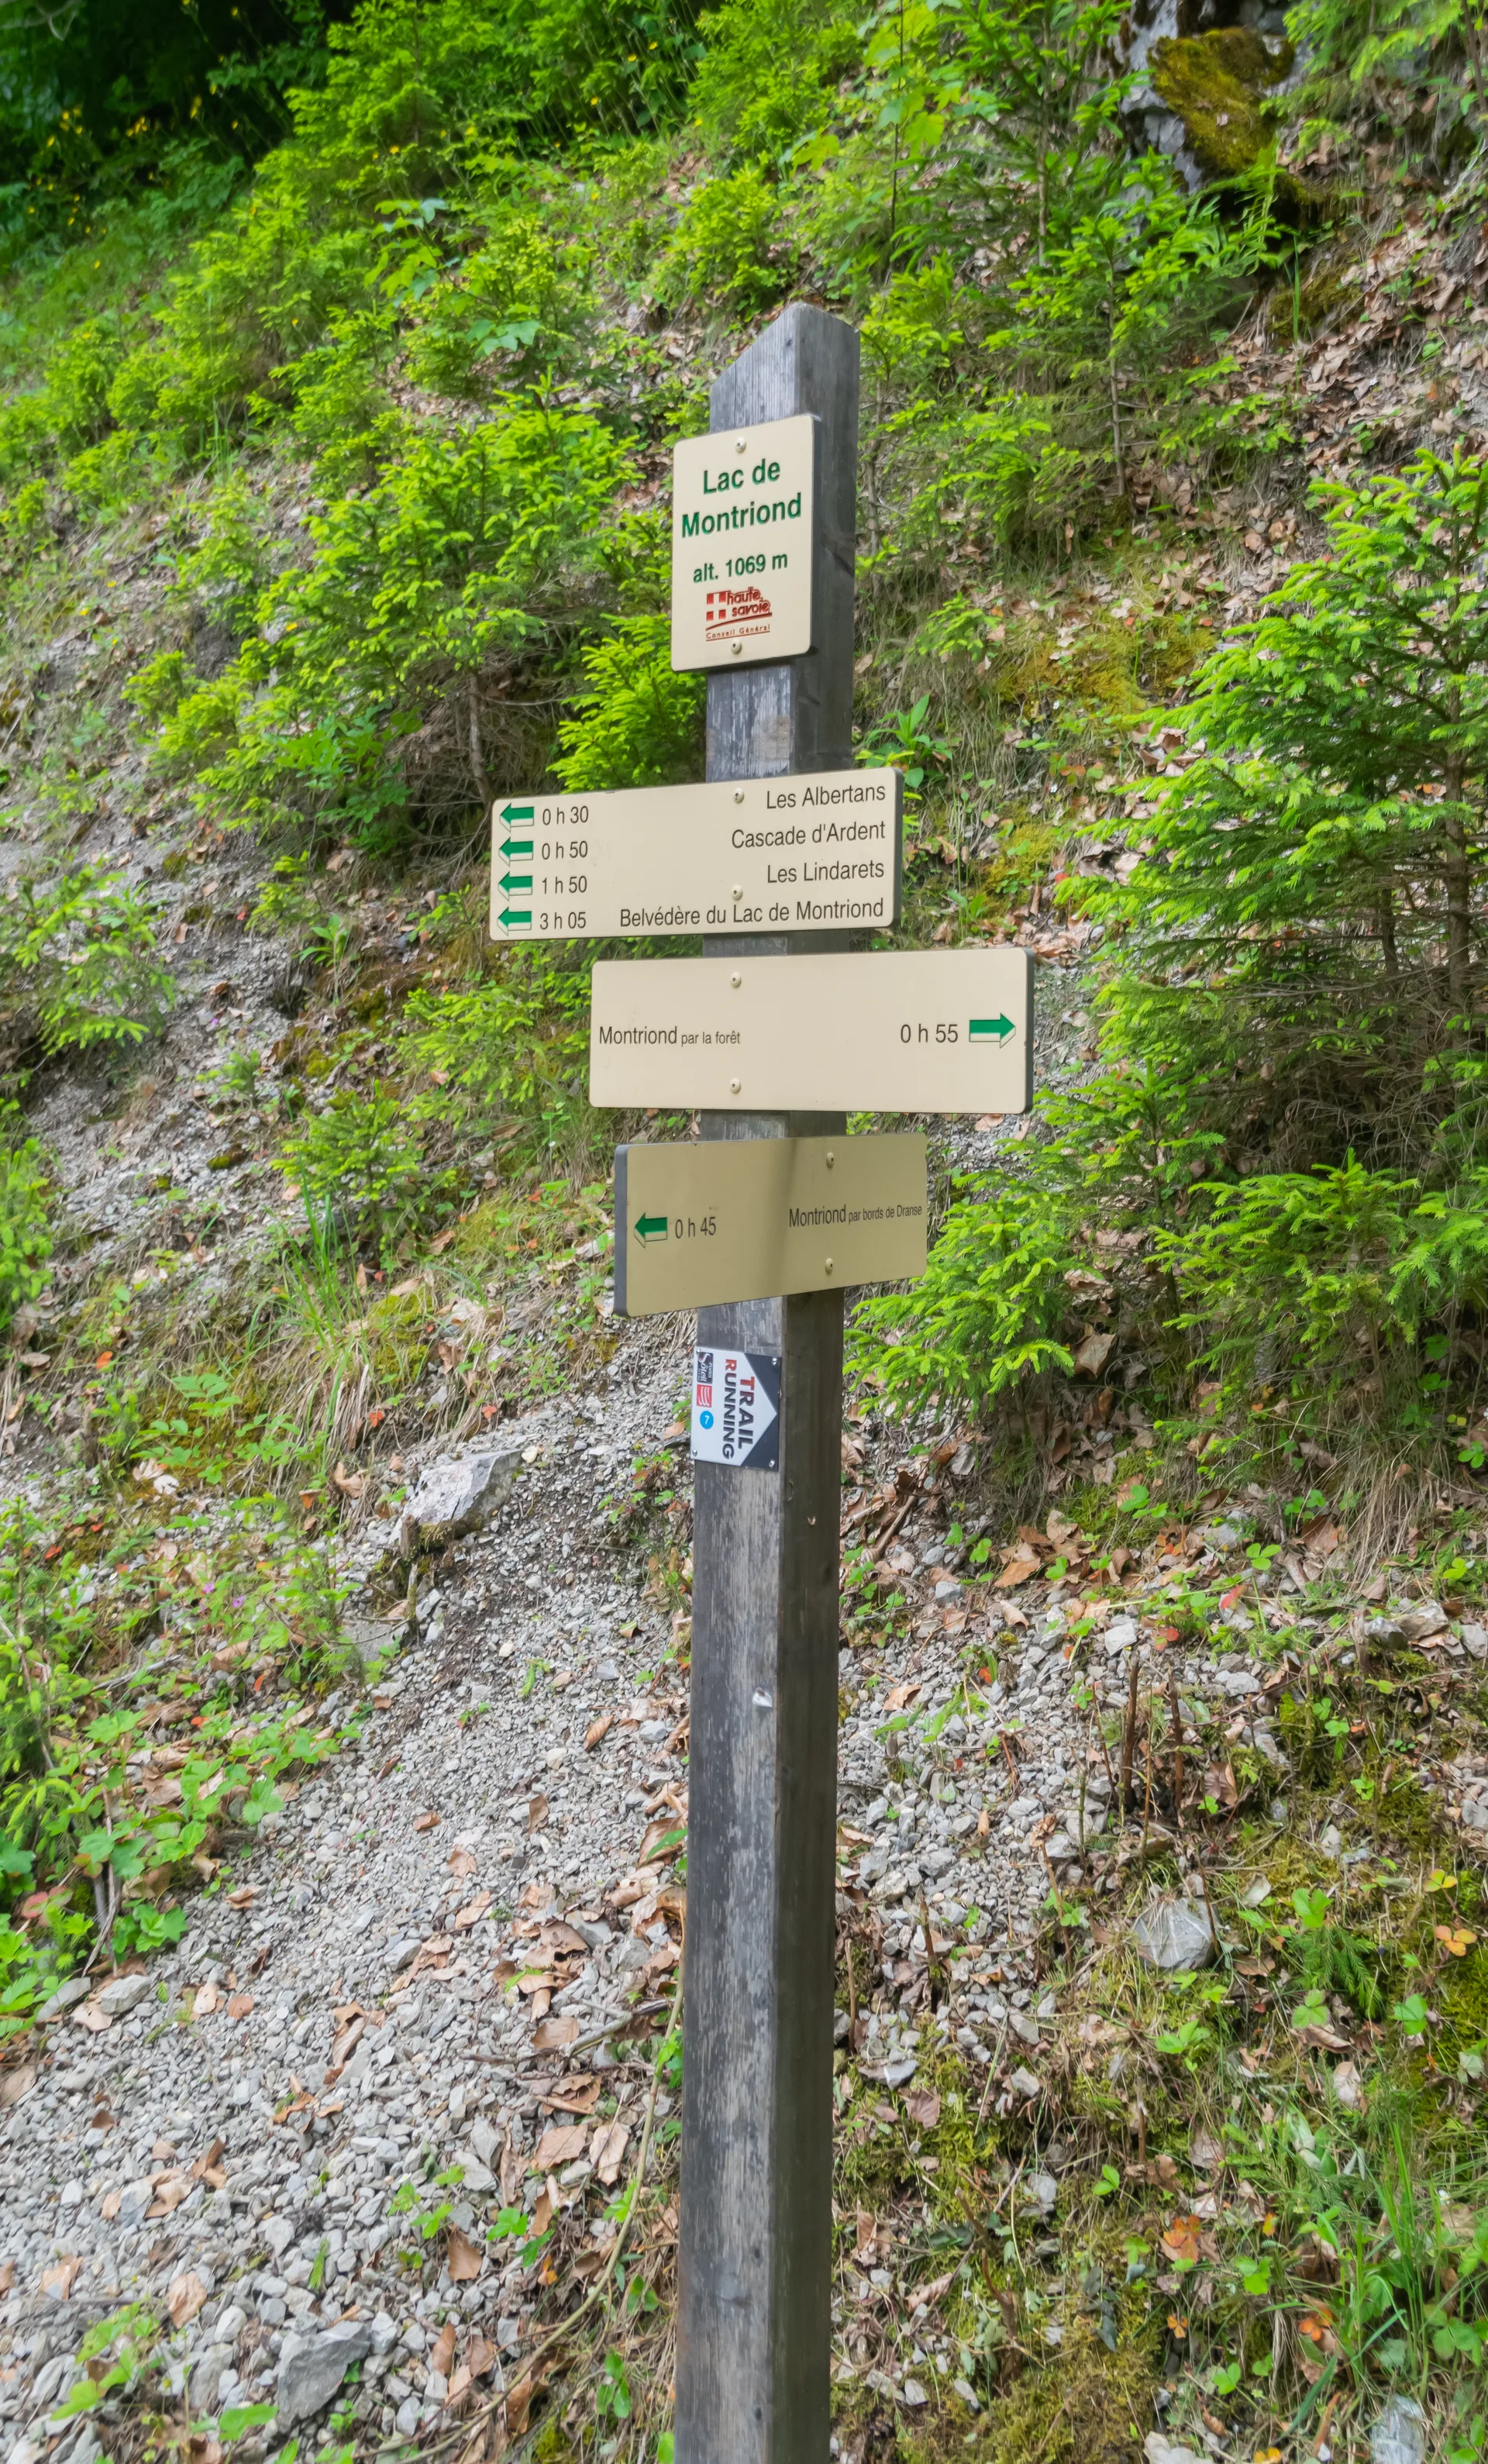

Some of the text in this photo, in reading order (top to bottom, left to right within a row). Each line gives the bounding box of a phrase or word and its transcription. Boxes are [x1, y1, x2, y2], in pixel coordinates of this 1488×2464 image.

[704, 459, 780, 495] Lac de
[682, 492, 801, 538] Montriond
[693, 553, 787, 583] alt. 1069 m
[727, 588, 761, 605] haute
[732, 600, 770, 617] savoie
[706, 624, 770, 639] Conseil Général
[766, 785, 886, 809] Les Albertans
[542, 806, 589, 825] 0 h 30
[732, 821, 885, 849] Cascade d'Ardent
[541, 841, 588, 860] 0 h 50
[767, 860, 884, 883] Les Lindarets
[542, 876, 587, 894] 1 h 50
[540, 912, 587, 930] 3 h 05
[621, 898, 884, 927] Belvédère du Lac de Montriond
[599, 1025, 741, 1047] Montriond par la forêt
[901, 1023, 959, 1043] 0 h 55
[789, 1204, 922, 1228] Montriond par bords de Dranse
[675, 1217, 716, 1239] 0 h 45
[722, 1359, 737, 1459] RUNNING
[738, 1377, 755, 1449] TRAIL
